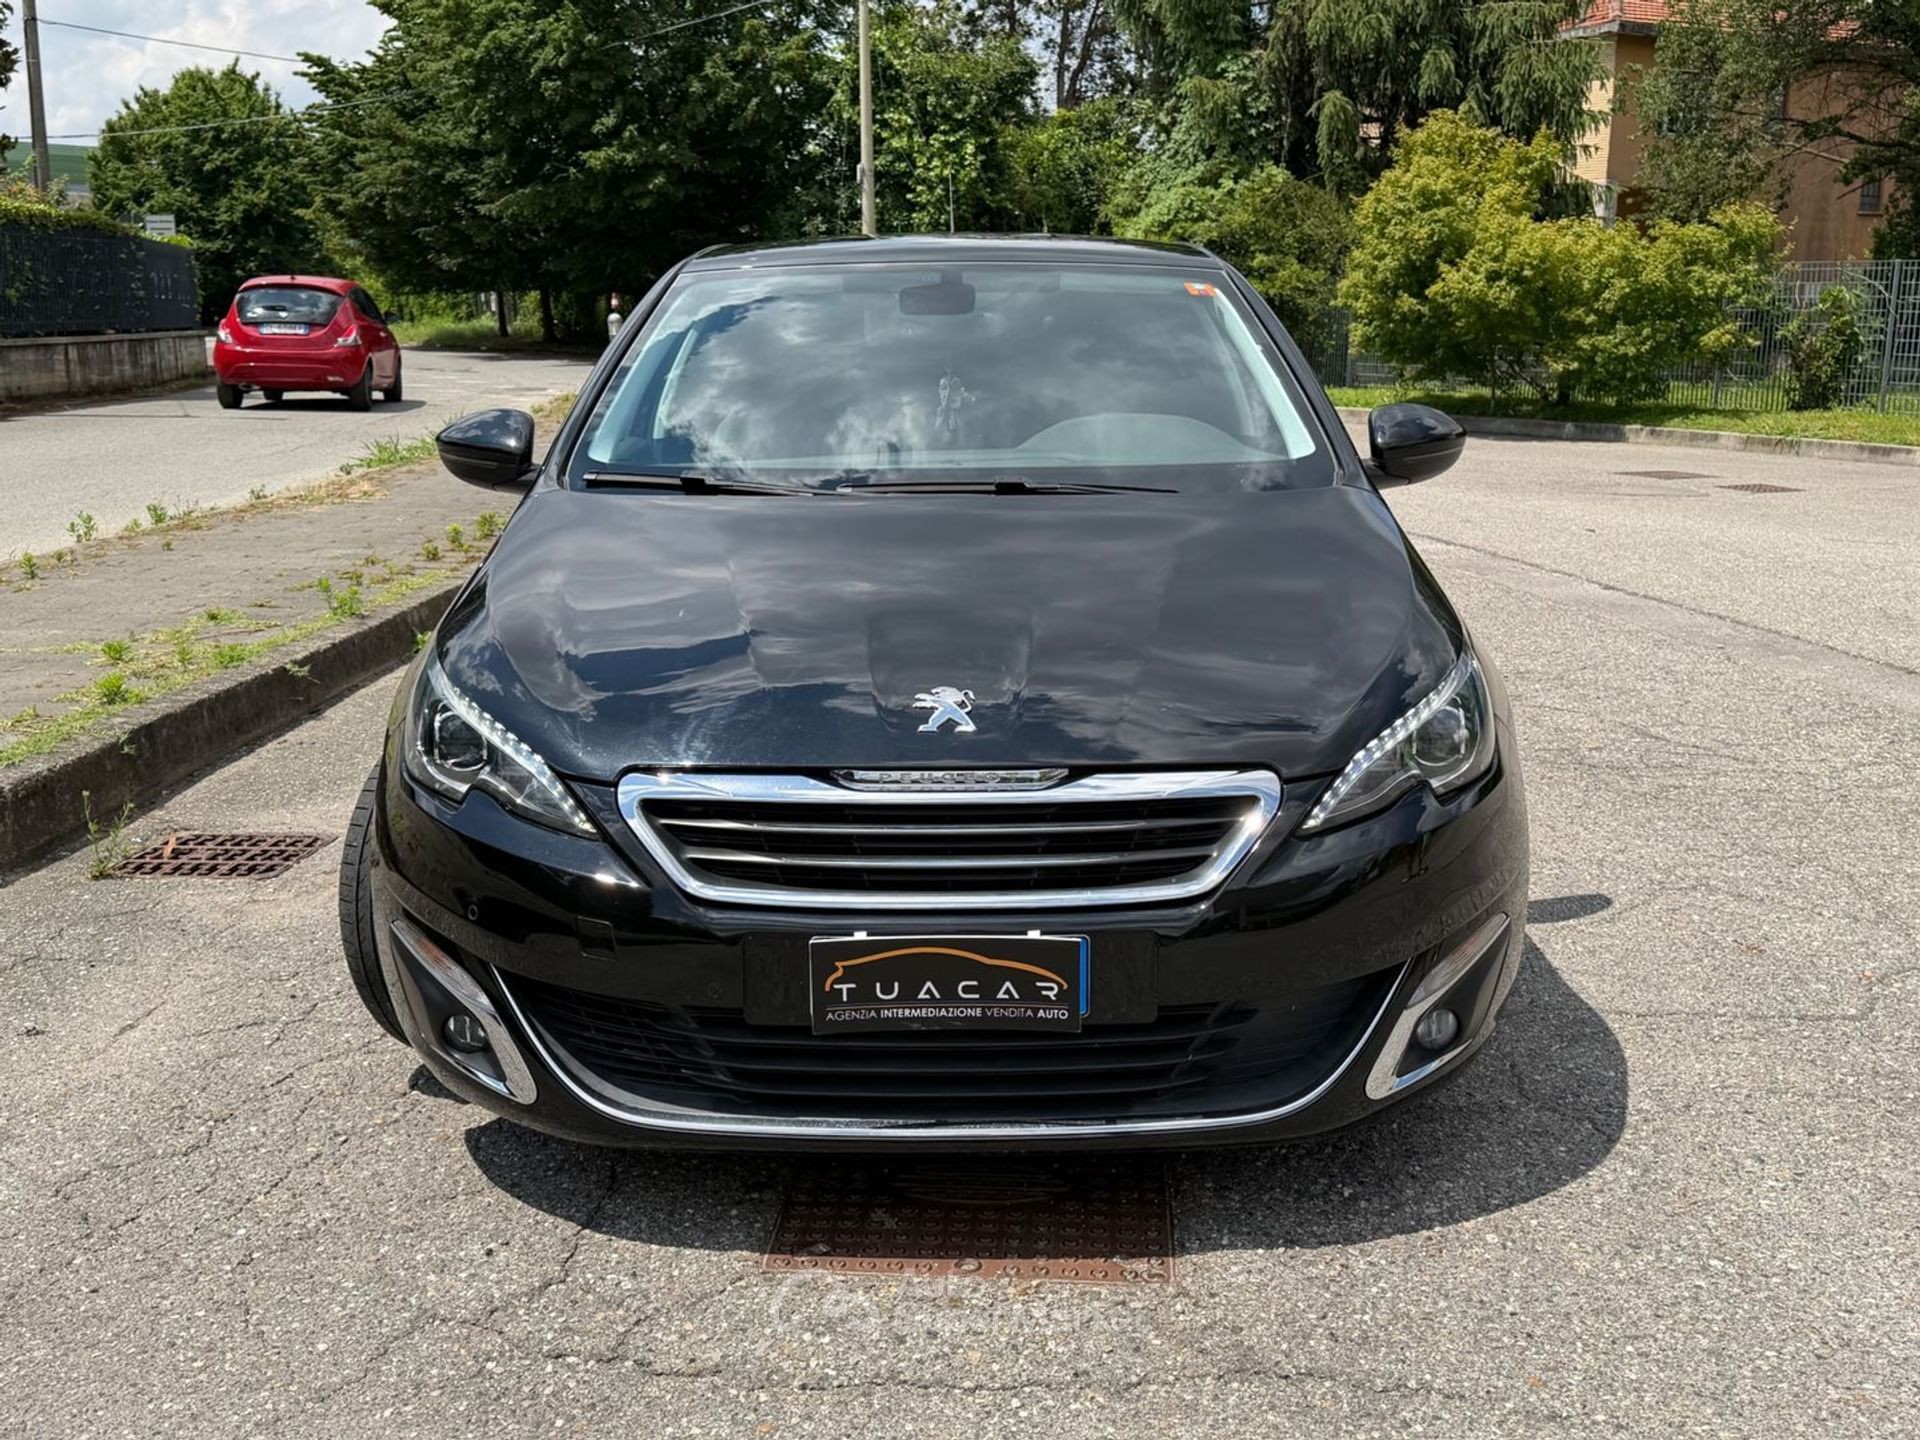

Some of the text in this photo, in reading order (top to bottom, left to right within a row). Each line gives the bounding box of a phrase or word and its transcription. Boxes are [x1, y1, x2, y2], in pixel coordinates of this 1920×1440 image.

[833, 980, 1059, 1002] TUACAR
[826, 1007, 1069, 1021] AGENZIA INTERMEDIAZIONE VENDITA AUTO
